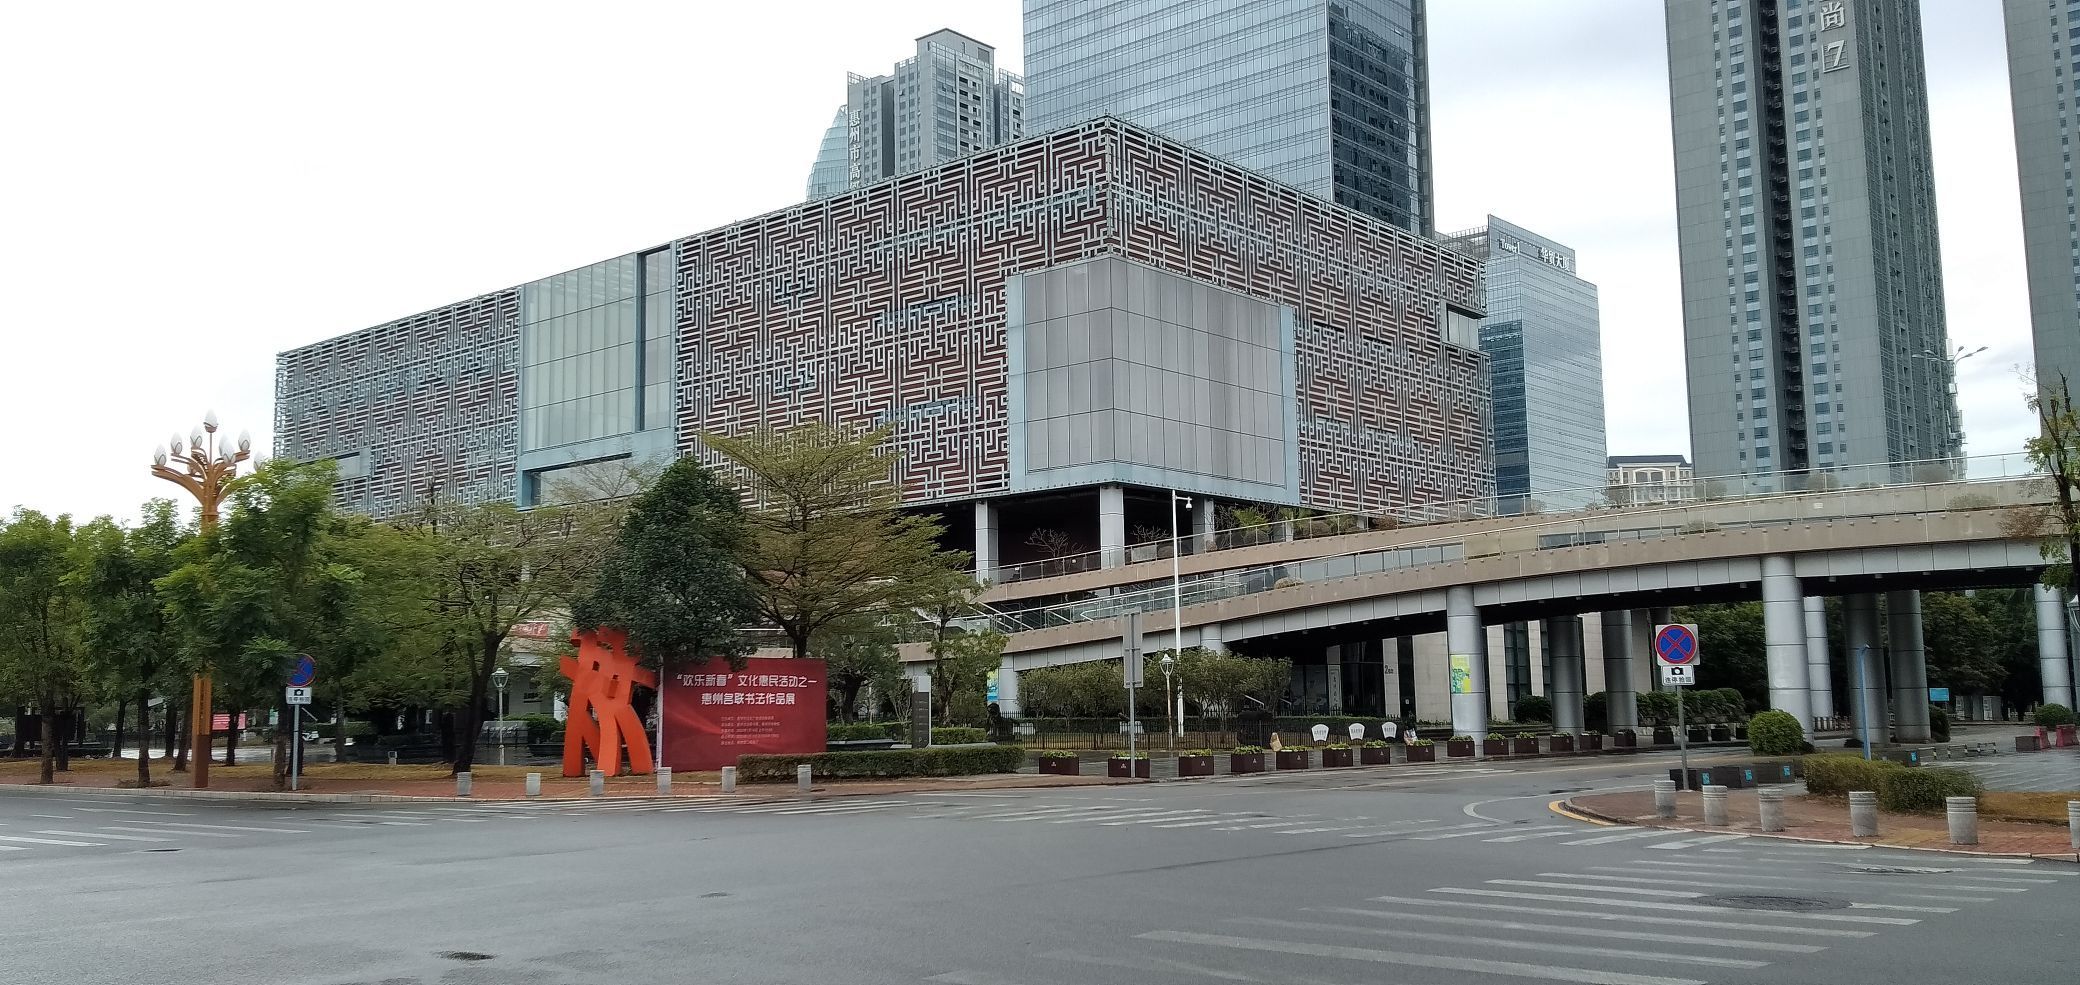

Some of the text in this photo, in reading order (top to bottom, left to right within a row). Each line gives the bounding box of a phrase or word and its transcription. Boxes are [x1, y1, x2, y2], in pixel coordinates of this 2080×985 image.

[701, 692, 796, 705] 惠州名联书法作品展
